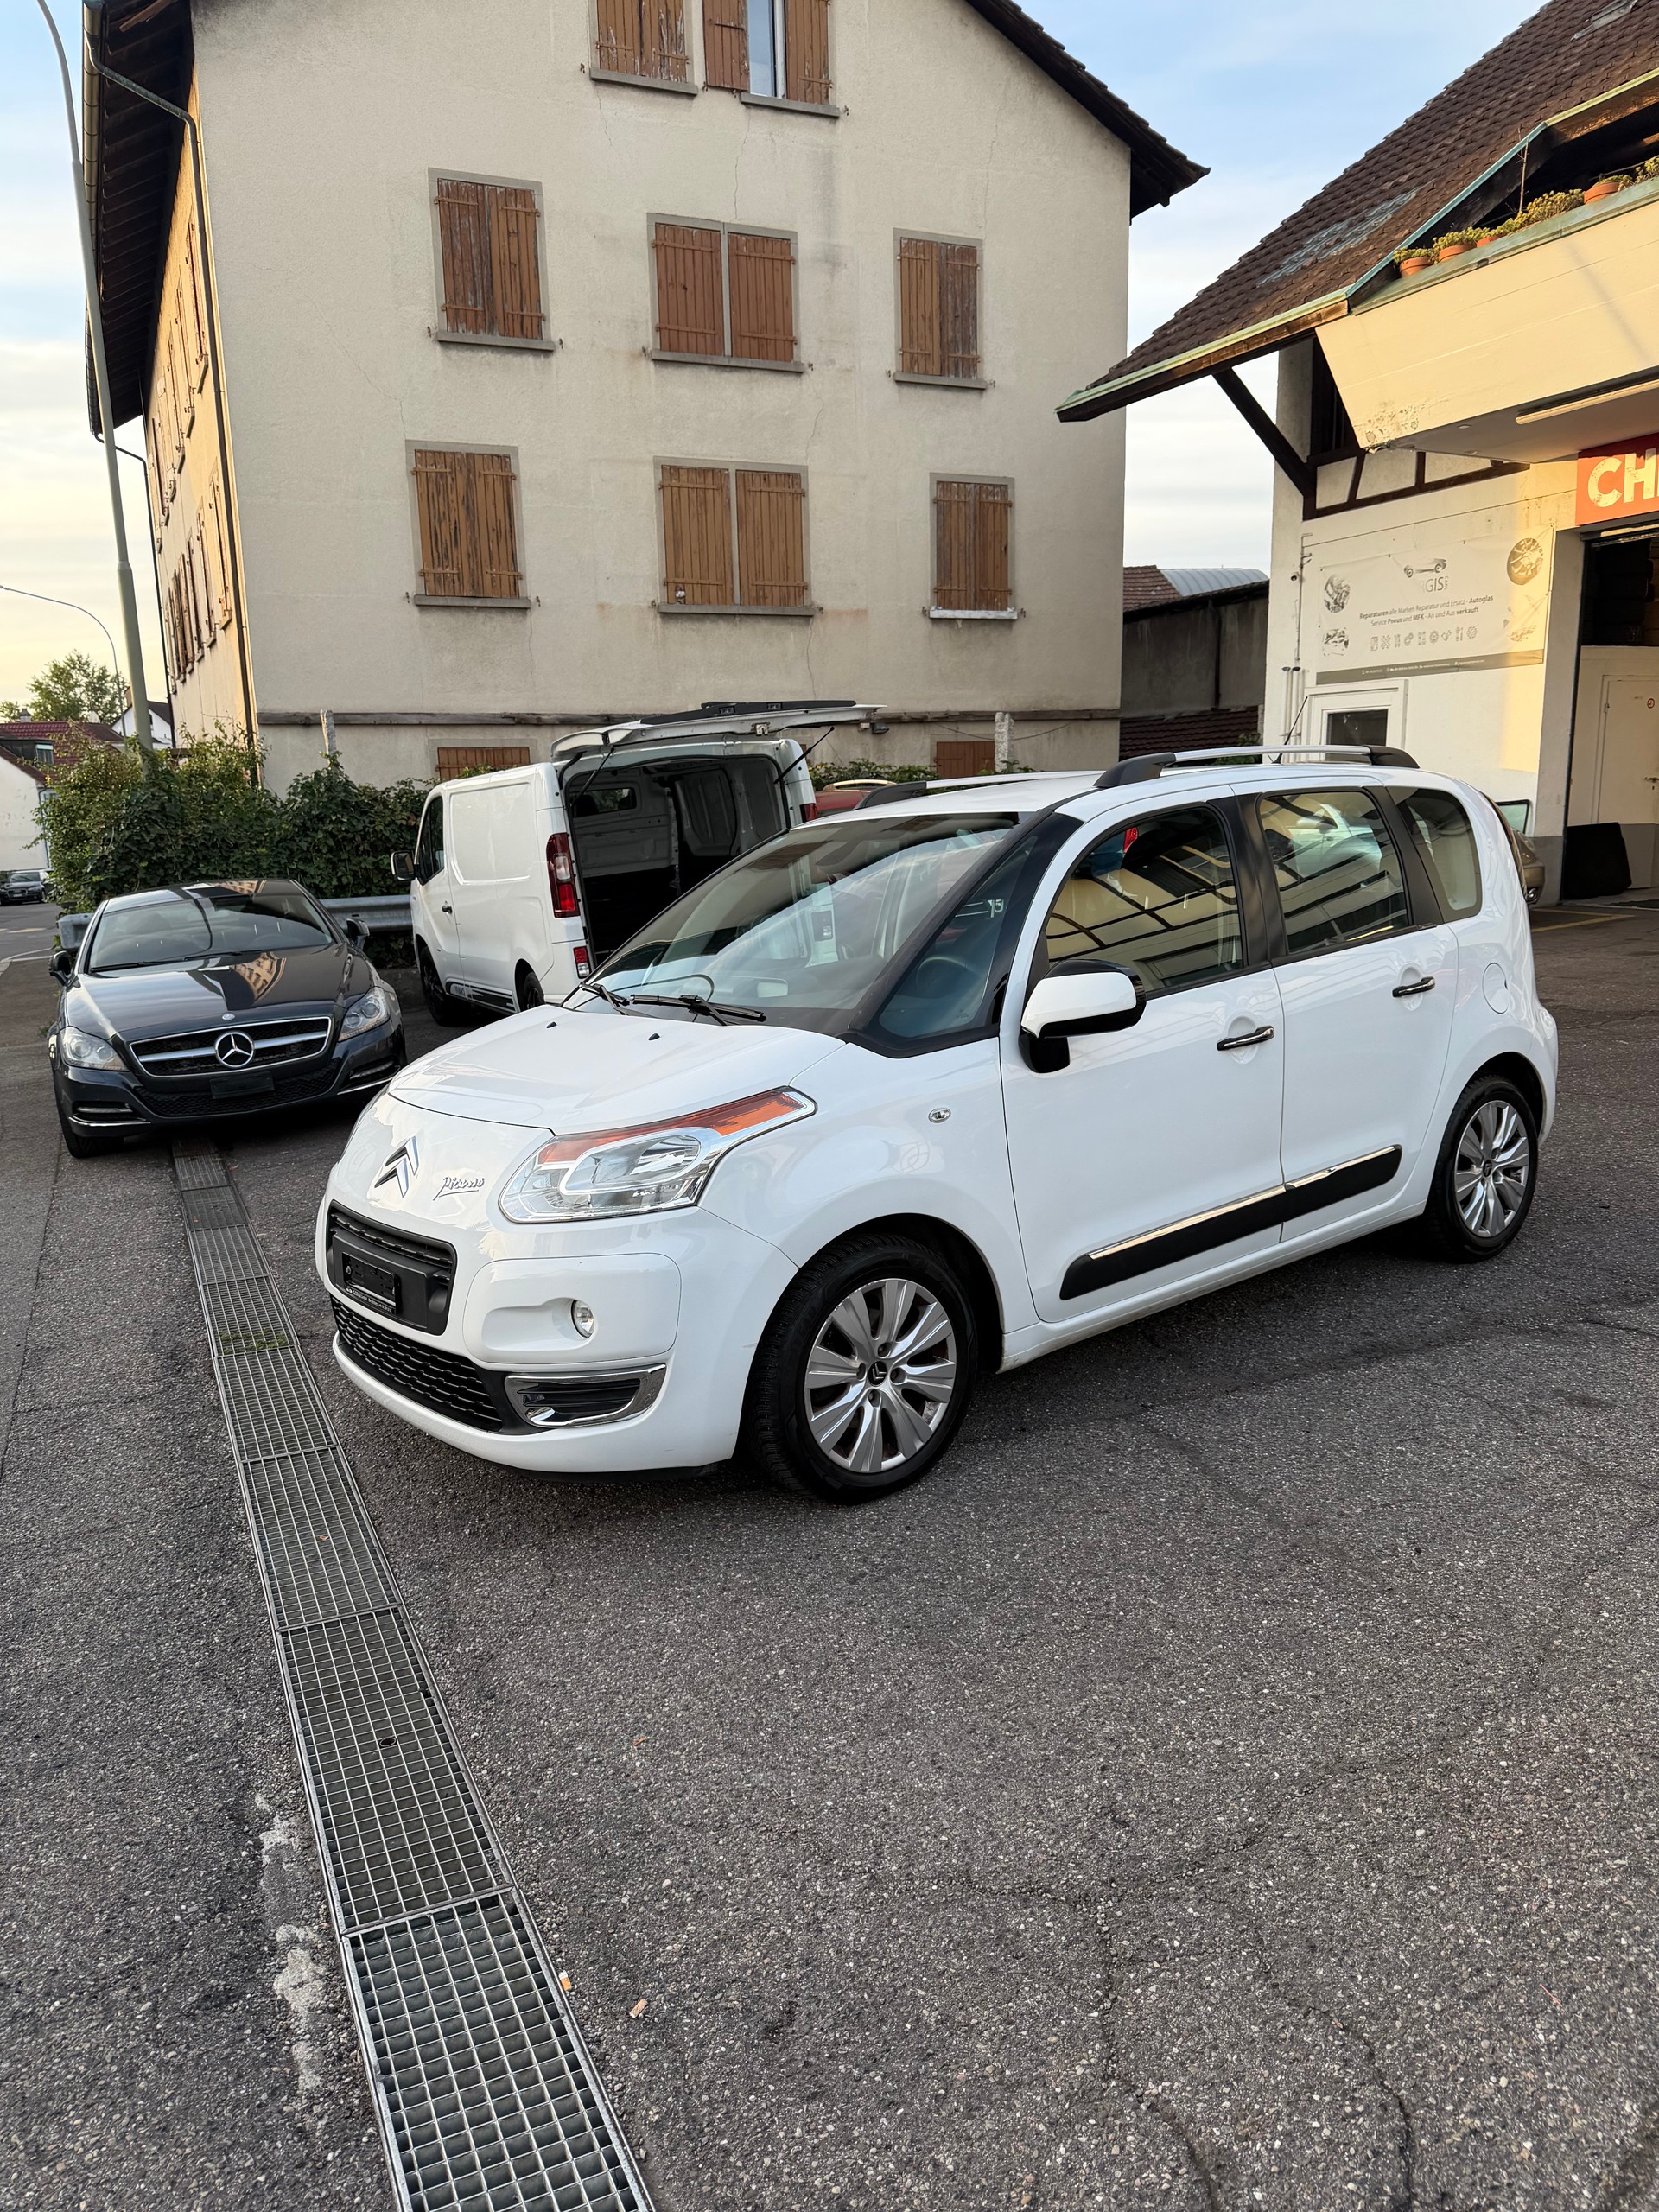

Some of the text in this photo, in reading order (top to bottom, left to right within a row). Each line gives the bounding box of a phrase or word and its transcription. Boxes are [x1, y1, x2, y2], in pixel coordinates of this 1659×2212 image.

[1587, 447, 1659, 507] CH
[1359, 610, 1389, 620] Reparaturen
[1456, 606, 1479, 614] verkauft
